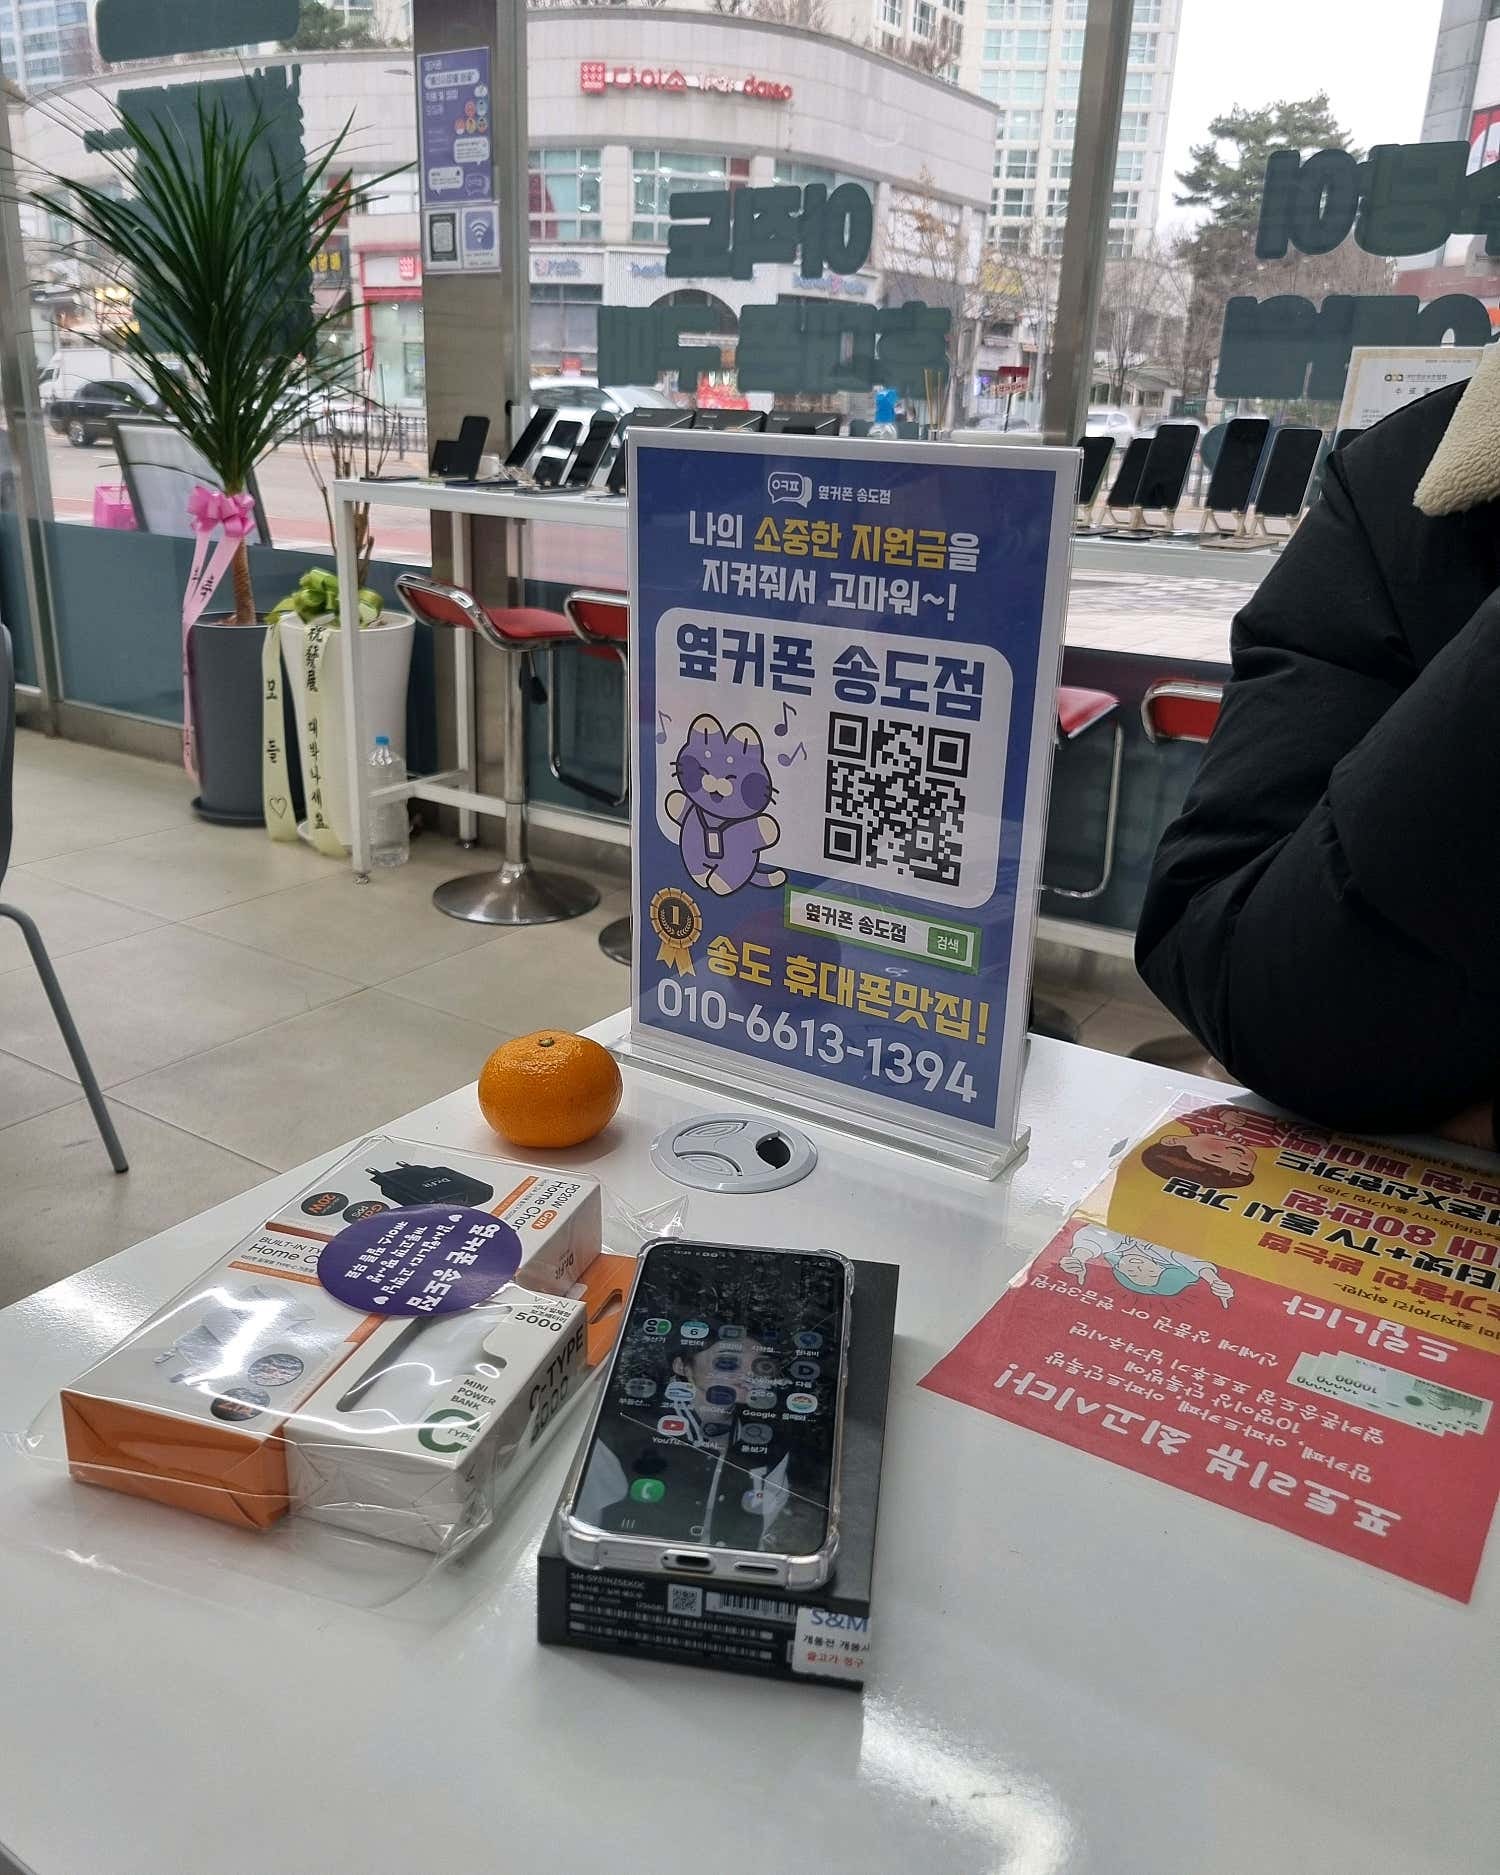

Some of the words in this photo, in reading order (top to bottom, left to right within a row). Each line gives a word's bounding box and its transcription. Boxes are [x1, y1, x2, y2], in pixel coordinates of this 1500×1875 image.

[613, 66, 687, 91] 다이소
[818, 485, 853, 502] 옆커폰
[856, 487, 891, 505] 송도점
[688, 511, 743, 549] 나의
[753, 517, 843, 560] 소중한
[850, 524, 980, 573] 지원금을
[702, 559, 817, 606] 지켜줘서
[827, 572, 957, 621] 고마워~!
[676, 623, 816, 697] 옆커폰
[832, 644, 985, 722] 송도점
[805, 902, 854, 931] 옆커폰
[858, 914, 907, 944] 송도점
[936, 935, 960, 954] 검색
[707, 935, 773, 987] 송도
[784, 955, 990, 1045] 휴대폰맛집!
[657, 978, 977, 1104] 010-6613-1394
[306, 1193, 335, 1215] 20W
[534, 1181, 567, 1205] Home
[551, 1183, 581, 1209] PD20W
[1162, 1176, 1238, 1211] 가입
[1353, 1193, 1407, 1215] 동시가입
[377, 1220, 409, 1246] 케이스
[532, 1210, 556, 1229] GaN
[1243, 1201, 1320, 1237] 동시
[1283, 1189, 1438, 1247] 80만원
[248, 1243, 299, 1262] Home
[259, 1236, 304, 1253] BUILT-IN
[358, 1247, 386, 1263] 필름
[395, 1225, 428, 1258] 개통고객
[409, 1225, 455, 1267] 감사합니다
[446, 1223, 500, 1266] 옆커폰
[1257, 1232, 1367, 1277] 받는법
[1447, 1234, 1500, 1268] 대
[344, 1264, 368, 1280] 무료
[366, 1259, 400, 1284] 평~생
[1325, 1229, 1500, 1291] 터넷+TV
[381, 1268, 415, 1294] 고객님
[406, 1268, 463, 1312] 송도점
[1031, 1274, 1114, 1311] 현금3만원
[1333, 1282, 1388, 1305] 하지만~
[515, 1312, 562, 1332] 5000
[1121, 1307, 1150, 1320] or
[1283, 1295, 1459, 1362] 드립니다
[1392, 1294, 1474, 1329] 최저가이긴
[1069, 1321, 1164, 1365] 남겨주시면
[1153, 1316, 1211, 1344] 상품권
[529, 1325, 586, 1411] C-TYPE
[1218, 1339, 1278, 1367] 신세계
[464, 1378, 488, 1391] MINI
[1045, 1351, 1165, 1401] 아파트단톡방
[1124, 1360, 1206, 1399] 단톡방에
[1172, 1359, 1251, 1394] 포토후기
[1335, 1375, 1378, 1394] 10000
[451, 1394, 480, 1411] BANK
[458, 1386, 496, 1406] POWER
[993, 1363, 1192, 1455] 최고시다!
[742, 1410, 776, 1419] Google
[1176, 1395, 1287, 1447] 아파트카페,
[1212, 1393, 1300, 1434] 10명이상
[1256, 1389, 1384, 1444] 옆커폰송도점
[1298, 1441, 1373, 1484] 맘카페,
[1206, 1443, 1403, 1537] 포토리뷰
[811, 1608, 868, 1632] S&M
